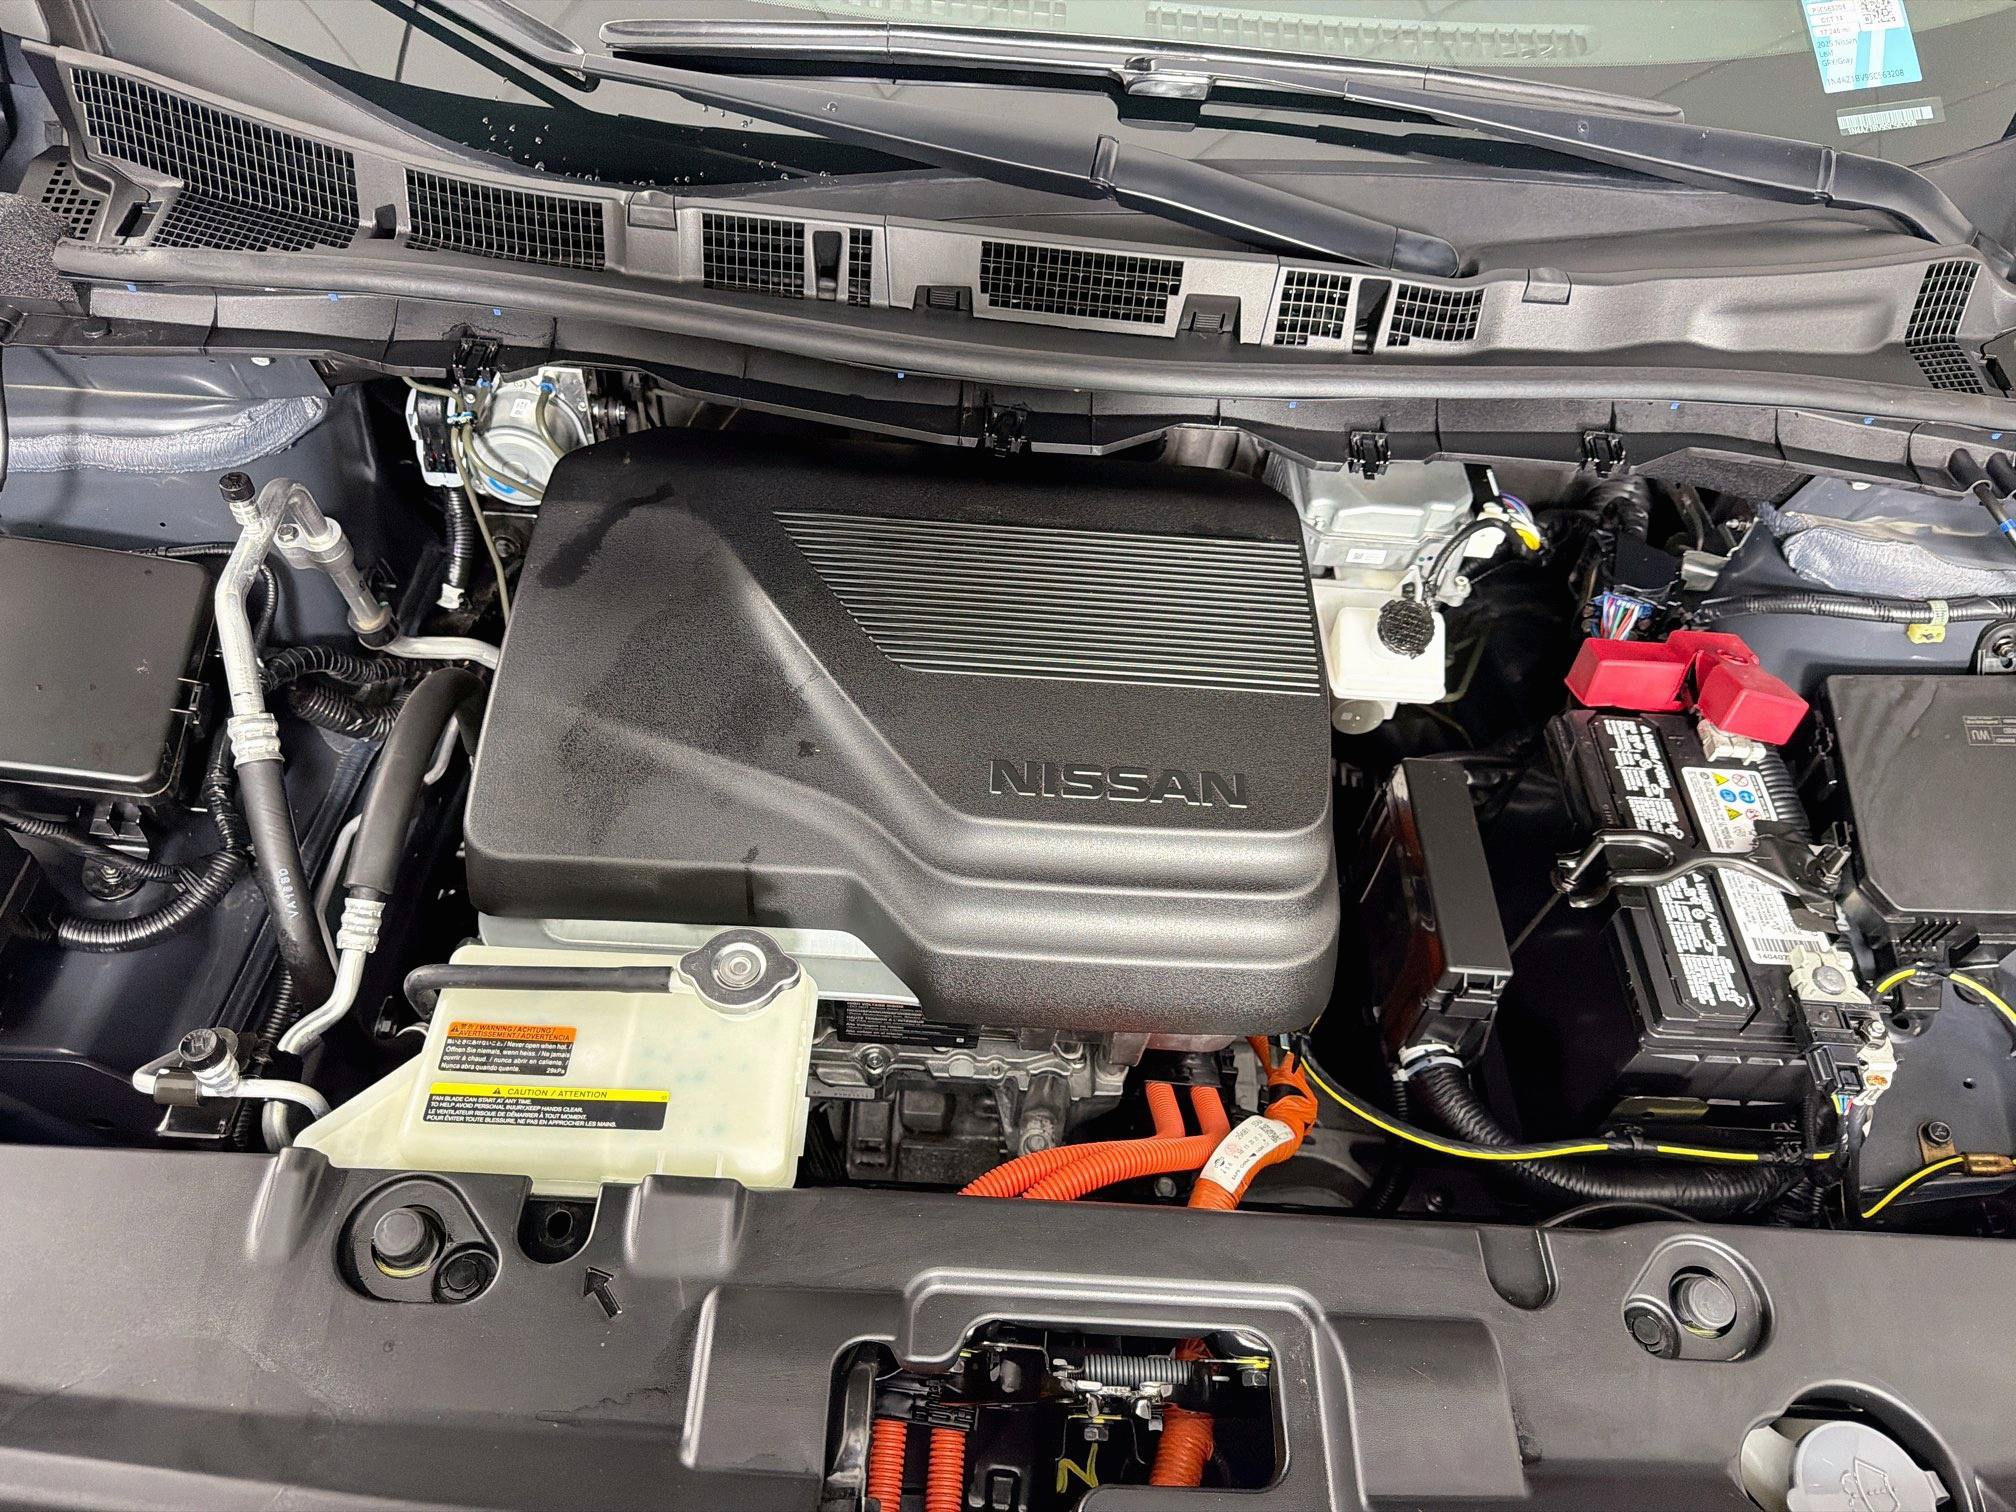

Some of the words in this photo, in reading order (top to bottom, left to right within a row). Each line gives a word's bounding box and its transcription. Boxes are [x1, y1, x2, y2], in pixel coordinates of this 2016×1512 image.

[989, 759, 1248, 809] NISSAN
[479, 1024, 513, 1032] WARNING
[516, 1026, 551, 1034] ACHTUNG
[458, 1030, 517, 1039] AVERTISSEMENT
[507, 1088, 549, 1097] CAUTION
[558, 1090, 608, 1098] ATTENTION
